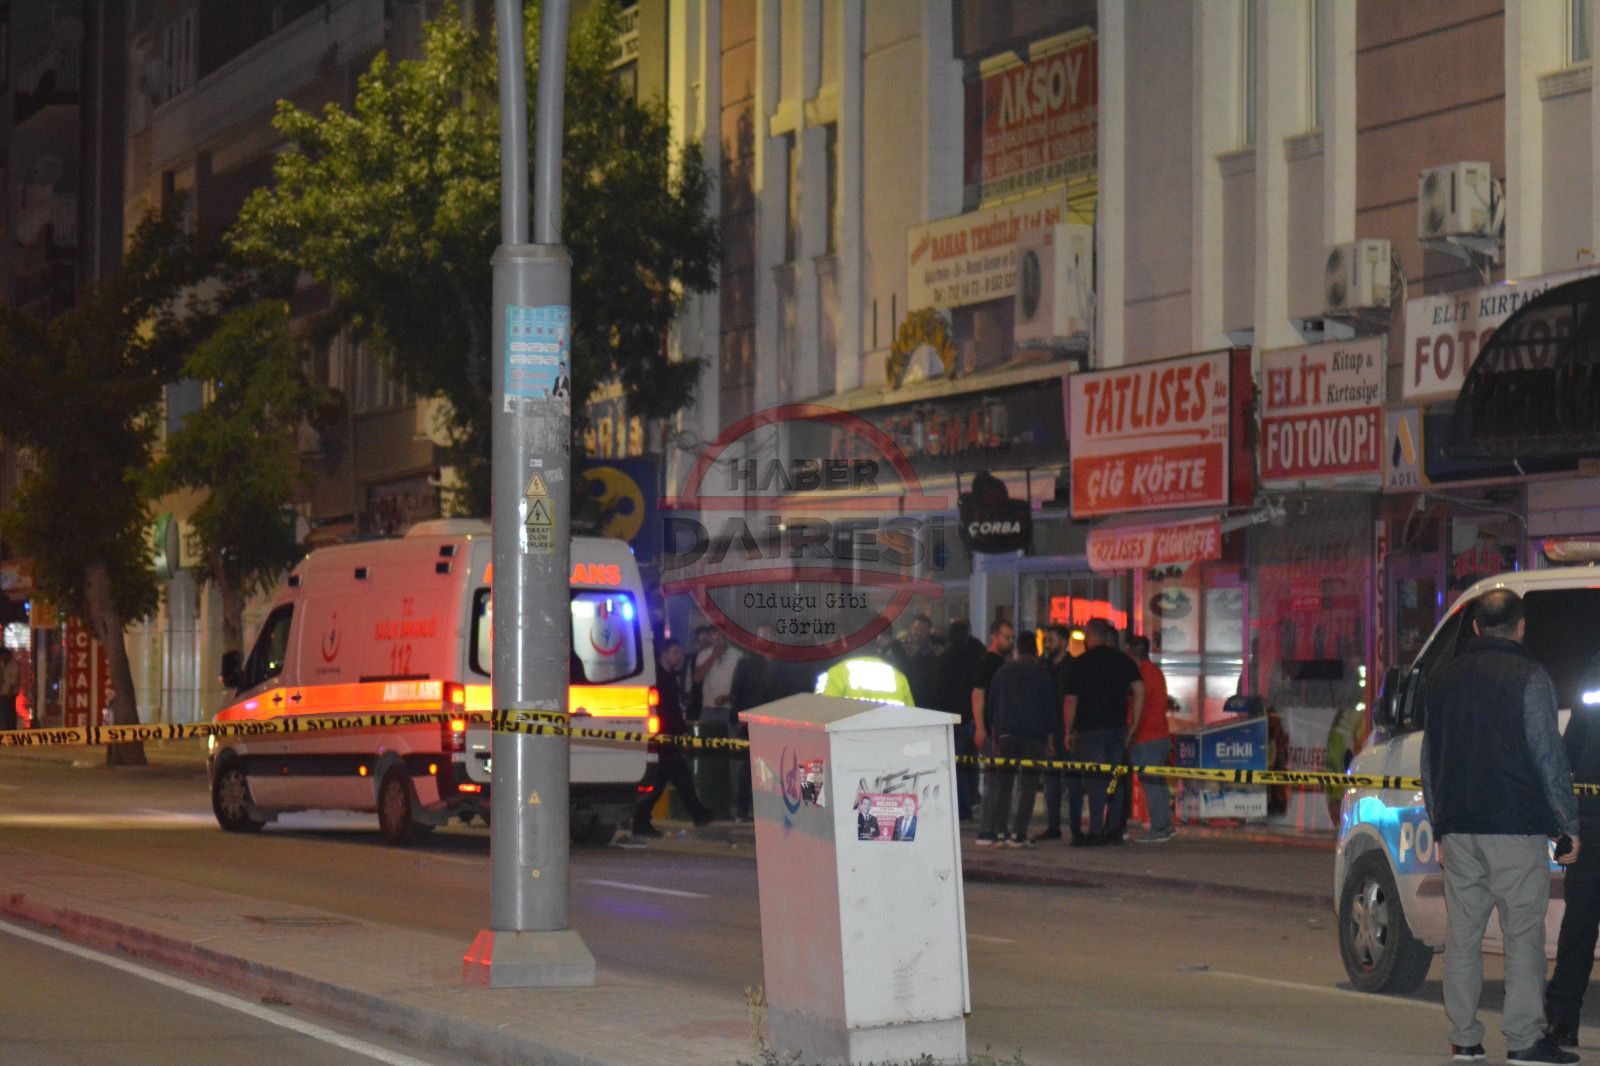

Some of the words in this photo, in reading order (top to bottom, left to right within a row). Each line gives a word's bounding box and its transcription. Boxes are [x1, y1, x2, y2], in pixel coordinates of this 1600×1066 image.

[999, 53, 1083, 129] AKSOY
[1433, 296, 1470, 325] ELİT
[1332, 351, 1364, 374] Kitap
[1366, 355, 1373, 367] &
[1267, 353, 1327, 409] ELİT
[1326, 378, 1379, 404] Kırtasiye
[1084, 362, 1211, 436] TATLISES
[1267, 413, 1376, 470] FOTOKOPİ
[1087, 459, 1126, 507] ÇİĞ
[1131, 455, 1207, 497] KÖFTE
[1391, 474, 1418, 486] ADEL
[968, 520, 1022, 537] ÇORBA
[390, 644, 412, 675] 112
[384, 680, 441, 702] AMBULANS
[107, 727, 163, 742] POLİS
[189, 723, 278, 737] GİRİLMEZ
[306, 717, 363, 732] POLİS
[1215, 742, 1253, 757] Erikli
